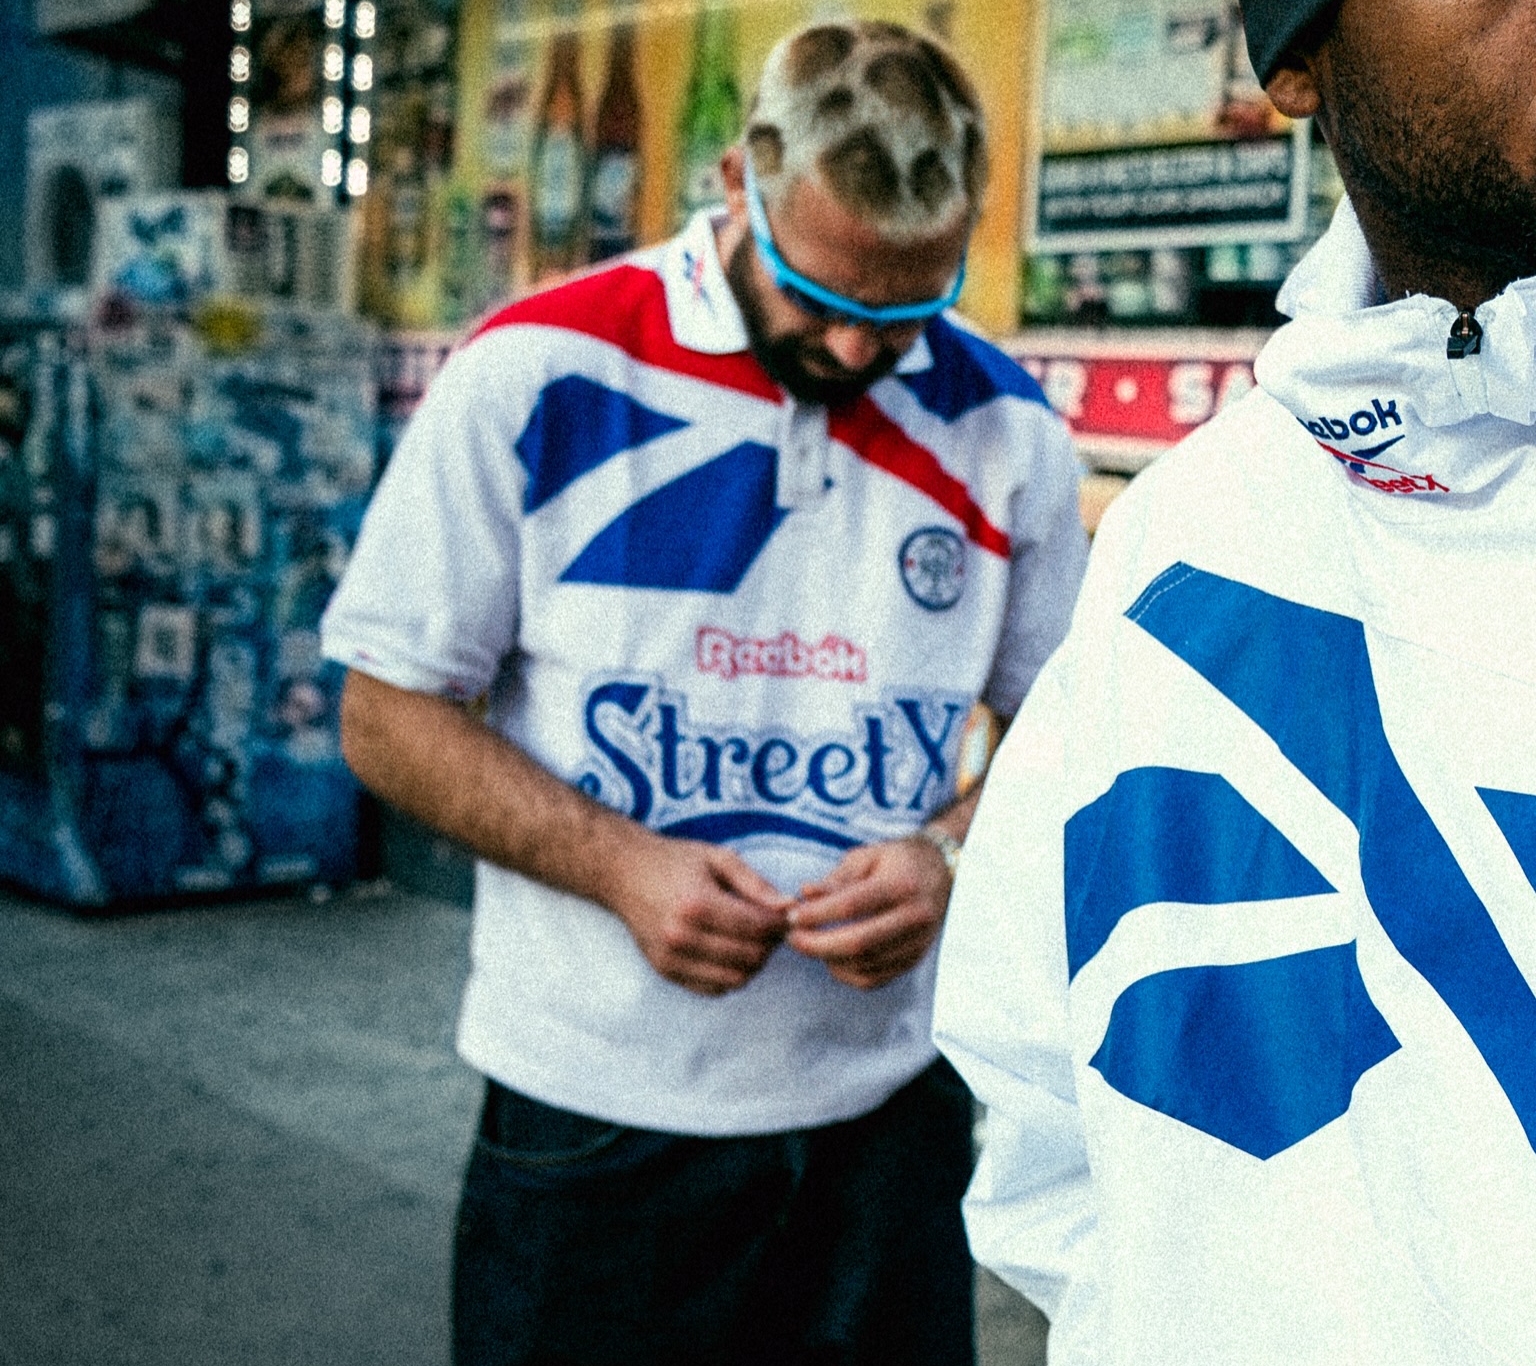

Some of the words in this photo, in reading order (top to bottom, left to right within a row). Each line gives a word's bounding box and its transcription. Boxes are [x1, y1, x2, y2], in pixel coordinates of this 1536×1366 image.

[1307, 398, 1402, 440] ebok
[697, 626, 867, 682] Reebok
[582, 683, 960, 821] StreetX
